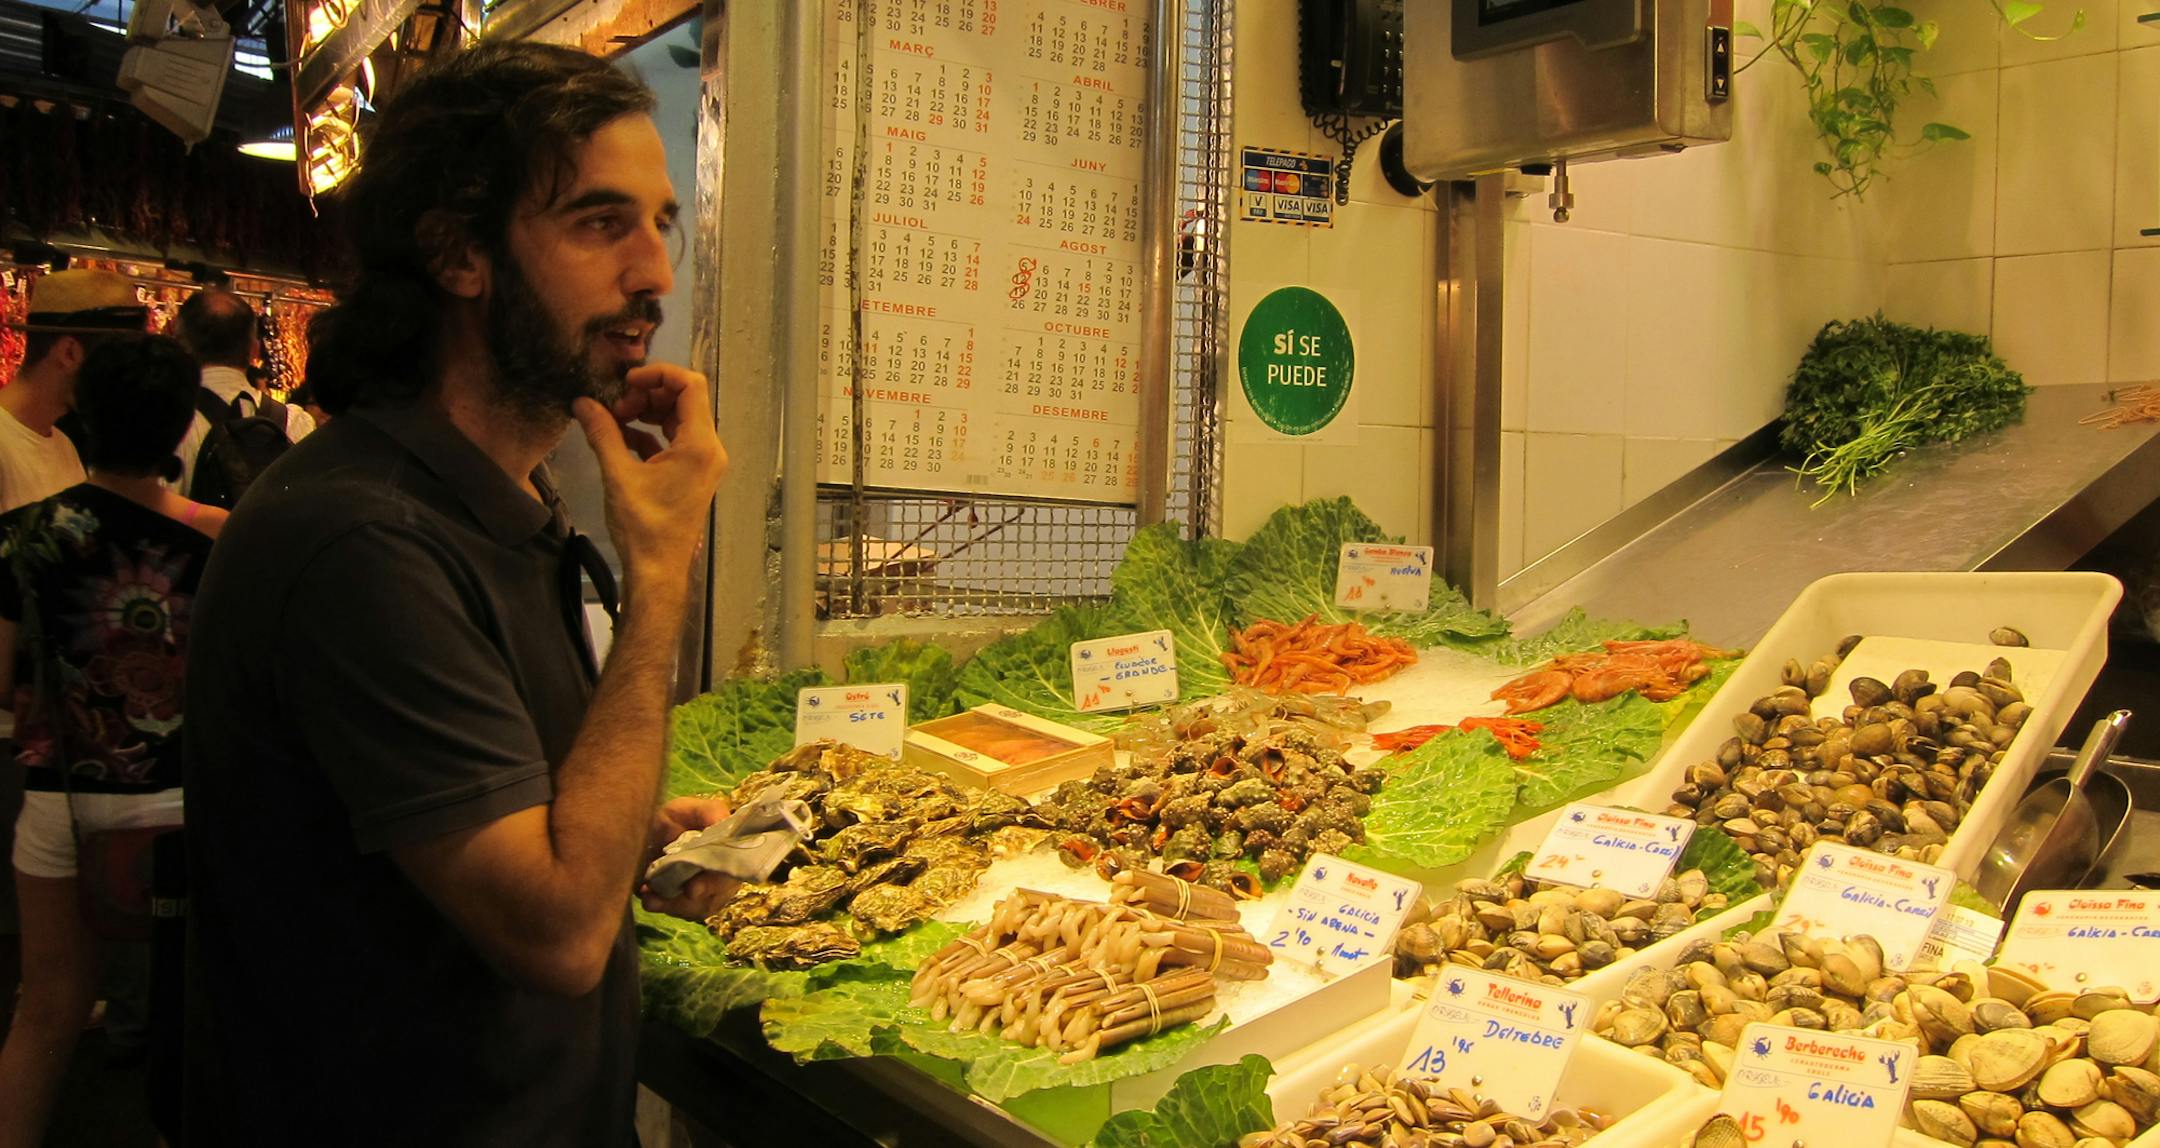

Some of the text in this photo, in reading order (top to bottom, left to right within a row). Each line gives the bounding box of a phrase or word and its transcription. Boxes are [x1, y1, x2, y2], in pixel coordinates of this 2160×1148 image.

[887, 6, 995, 36] 23 24 25 26 27
[887, 20, 923, 35] 30 31
[890, 40, 934, 58] MARÇ
[1029, 47, 1105, 72] 25 26 27 28
[1073, 75, 1114, 91] ABRIL
[882, 93, 989, 120] 20 21 22 23 24
[881, 106, 987, 133] 27 28 29 30 31
[887, 127, 926, 141] MAIG
[1023, 131, 1058, 145] 29 30
[1024, 118, 1142, 148] 22 23 24 25 26 27
[1072, 158, 1106, 172] JUNY
[876, 180, 984, 205] 22 23 24 25 26
[875, 193, 935, 211] 29 30 31
[1278, 200, 1300, 210] VISA
[1306, 202, 1328, 213] VISA
[873, 212, 928, 229] JULIOL
[1017, 214, 1136, 242] 24 25 26 27 28 29
[1060, 240, 1107, 255] AGOST
[867, 281, 881, 292] 31
[870, 268, 978, 290] 24 25 26 27 28
[862, 299, 937, 317] ETEMBRE
[1034, 290, 1130, 310] 20 21 22 23 24
[1034, 302, 1128, 323] 27 28 29 30 31
[1045, 322, 1110, 338] OCTUBRE
[1274, 329, 1320, 356] SÍ SE
[888, 359, 971, 376] 19 20 21 22
[1268, 364, 1327, 387] PUEDE
[886, 371, 970, 389] 26 27 28 29
[1006, 370, 1124, 392] 21 22 23 24 25 26
[843, 387, 932, 404] NVEMBRE
[1005, 383, 1082, 400] 28 29 30 31
[1033, 404, 1108, 420] DESEMBRE
[880, 458, 941, 472] 28 29 30
[1000, 456, 1117, 473] 16 17 18 19 20 21
[1084, 474, 1117, 486] 27 28
[2116, 899, 2145, 910] Fina
[1921, 942, 1944, 957] FINA
[1785, 1036, 1865, 1061] Berberecho
[1739, 1111, 1765, 1141] 15
